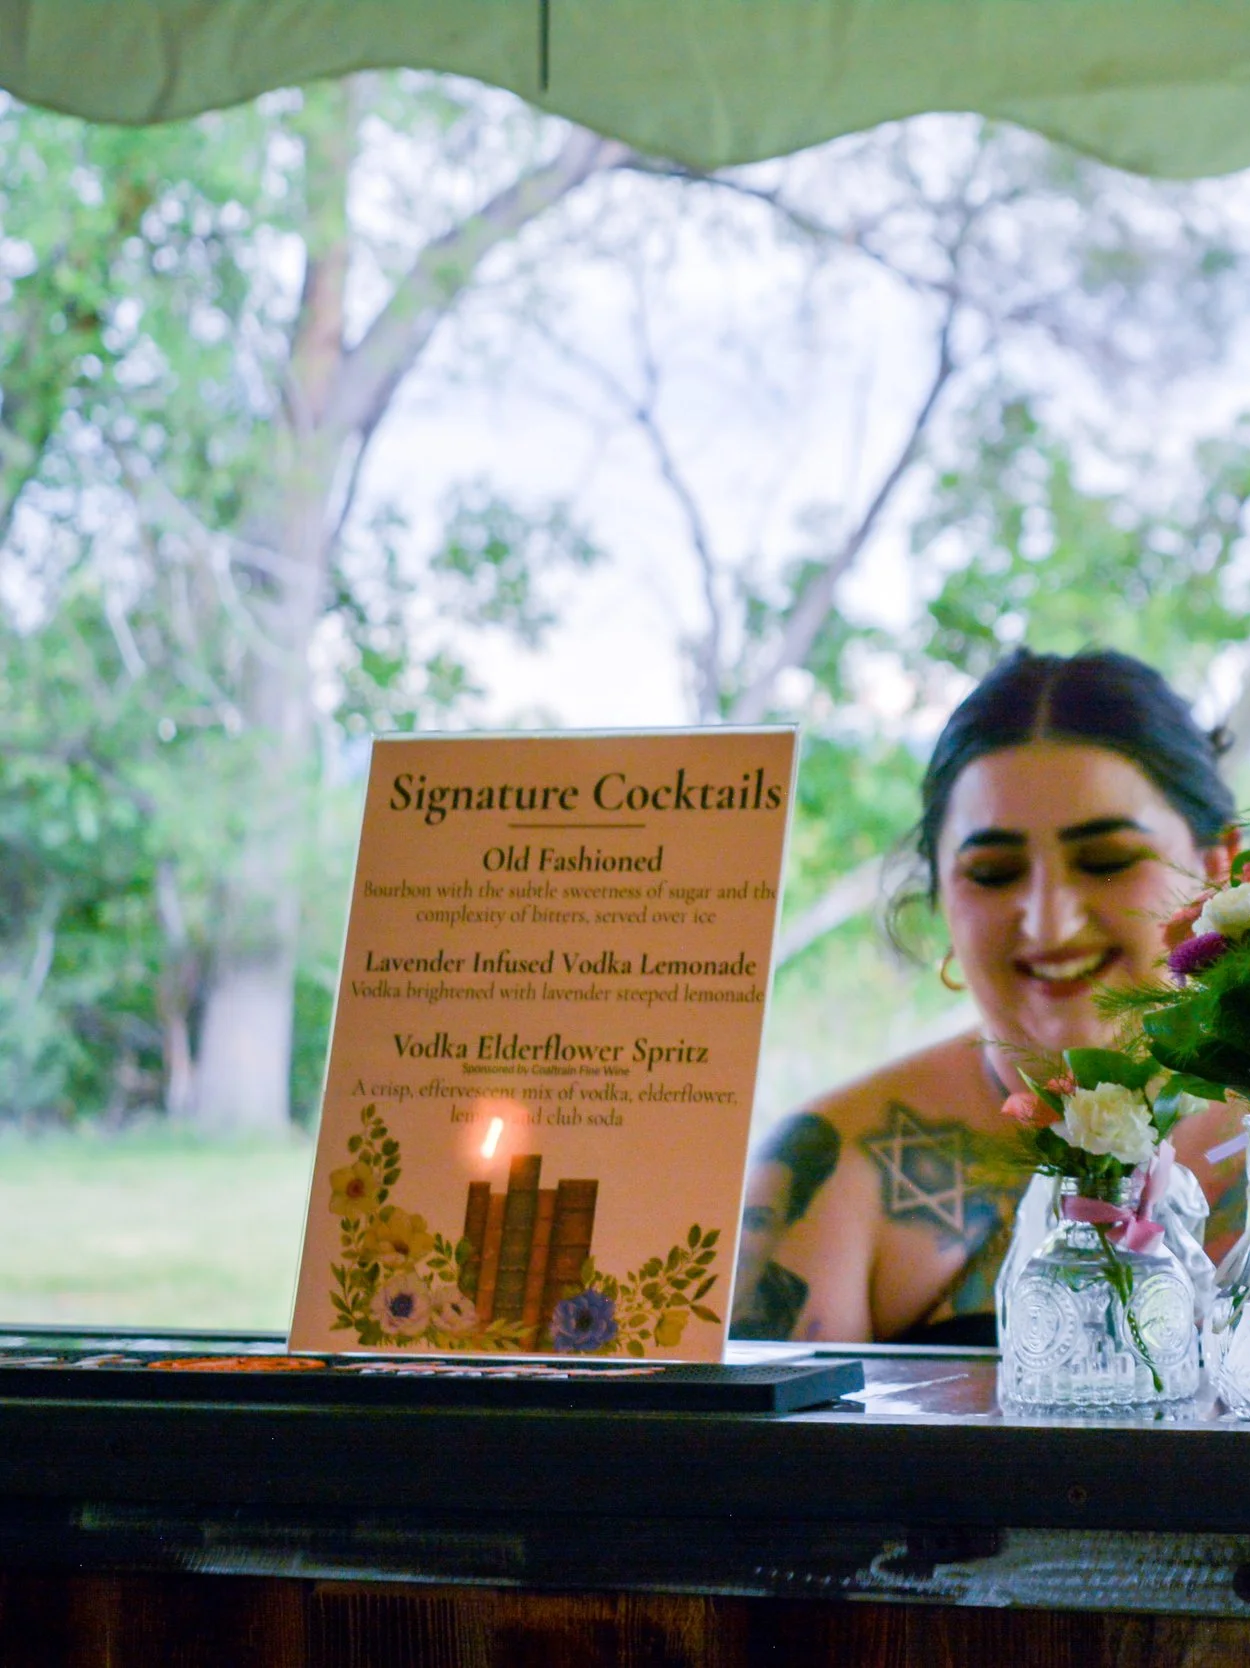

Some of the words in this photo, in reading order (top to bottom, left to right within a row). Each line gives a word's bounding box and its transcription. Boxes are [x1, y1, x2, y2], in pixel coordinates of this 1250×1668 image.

[390, 773, 578, 826] Signature
[593, 767, 782, 811] Cocktails
[482, 846, 530, 871] Old
[538, 846, 663, 873] Fashioned
[364, 879, 431, 898] Bourbon
[436, 878, 473, 898] with
[479, 880, 504, 898] the
[508, 879, 558, 898] subtle
[563, 884, 641, 899] sweetness
[646, 880, 668, 899] of
[669, 885, 711, 905] sugar
[716, 880, 749, 900] and
[416, 903, 506, 928] complexity
[510, 904, 534, 923] of
[532, 905, 590, 924] bitters,
[595, 905, 647, 924] served
[652, 911, 688, 925] over
[693, 909, 717, 924] ice
[366, 949, 465, 973] Lavender
[473, 949, 554, 974] Infused
[562, 951, 632, 975] Vodka
[640, 952, 757, 976] Lemonade
[351, 980, 401, 999] Vodka
[406, 981, 495, 1005] brightened
[500, 981, 537, 1000] with
[543, 982, 612, 1000] lavender
[616, 983, 679, 1007] steeped
[684, 983, 765, 1003] lemonade
[394, 1032, 468, 1059] Vodka
[476, 1034, 624, 1062] Elderflower
[632, 1038, 709, 1072] Spritz
[517, 1062, 527, 1076] by
[352, 1079, 366, 1097] A
[371, 1082, 414, 1101] crisp,
[419, 1078, 517, 1099] effervescent
[522, 1083, 552, 1100] mix
[557, 1081, 579, 1100] of
[580, 1083, 632, 1103] vodka,
[638, 1083, 738, 1105] elderflower,
[547, 1107, 582, 1126] club
[587, 1108, 623, 1127] soda
